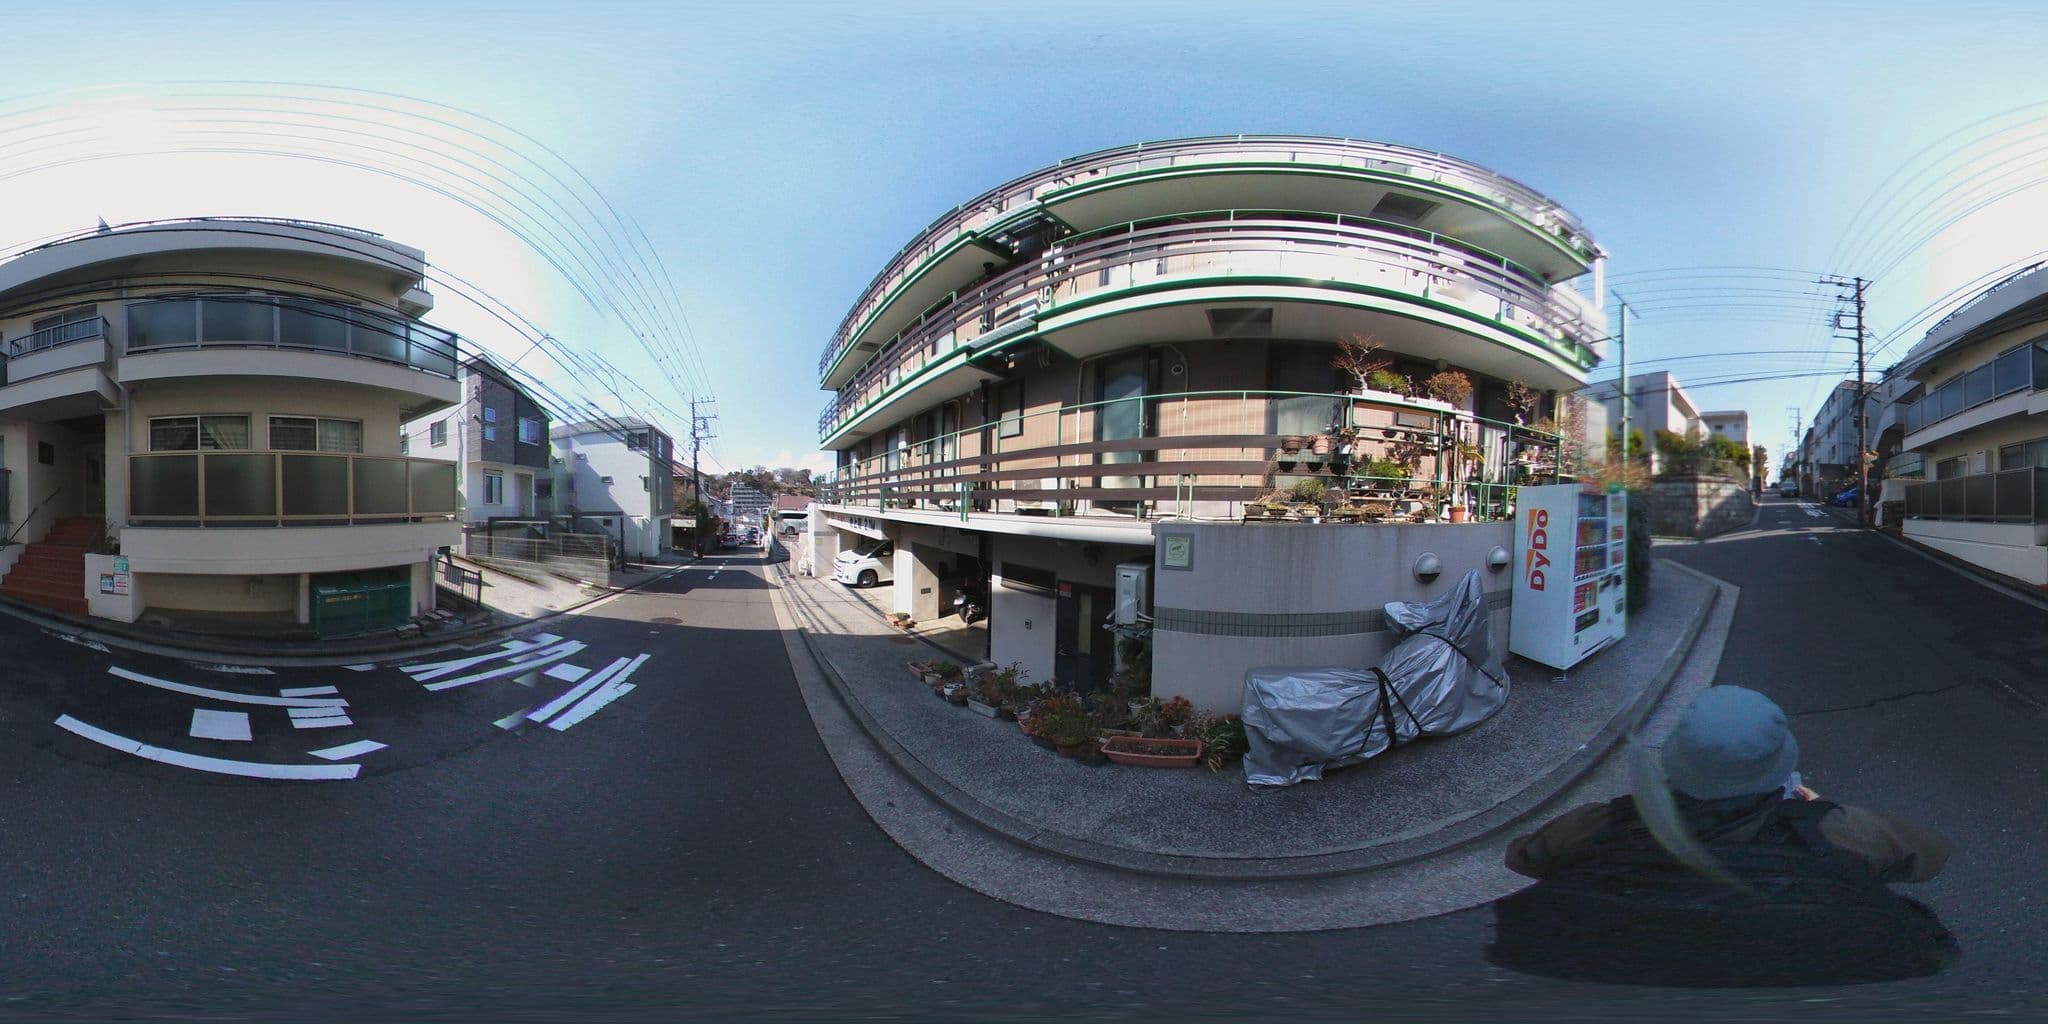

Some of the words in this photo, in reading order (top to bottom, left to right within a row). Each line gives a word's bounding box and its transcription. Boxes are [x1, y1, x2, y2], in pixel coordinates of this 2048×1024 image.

[1530, 509, 1550, 591] DyDo
[54, 666, 389, 780] ゾーン
[399, 632, 651, 731] スクール
